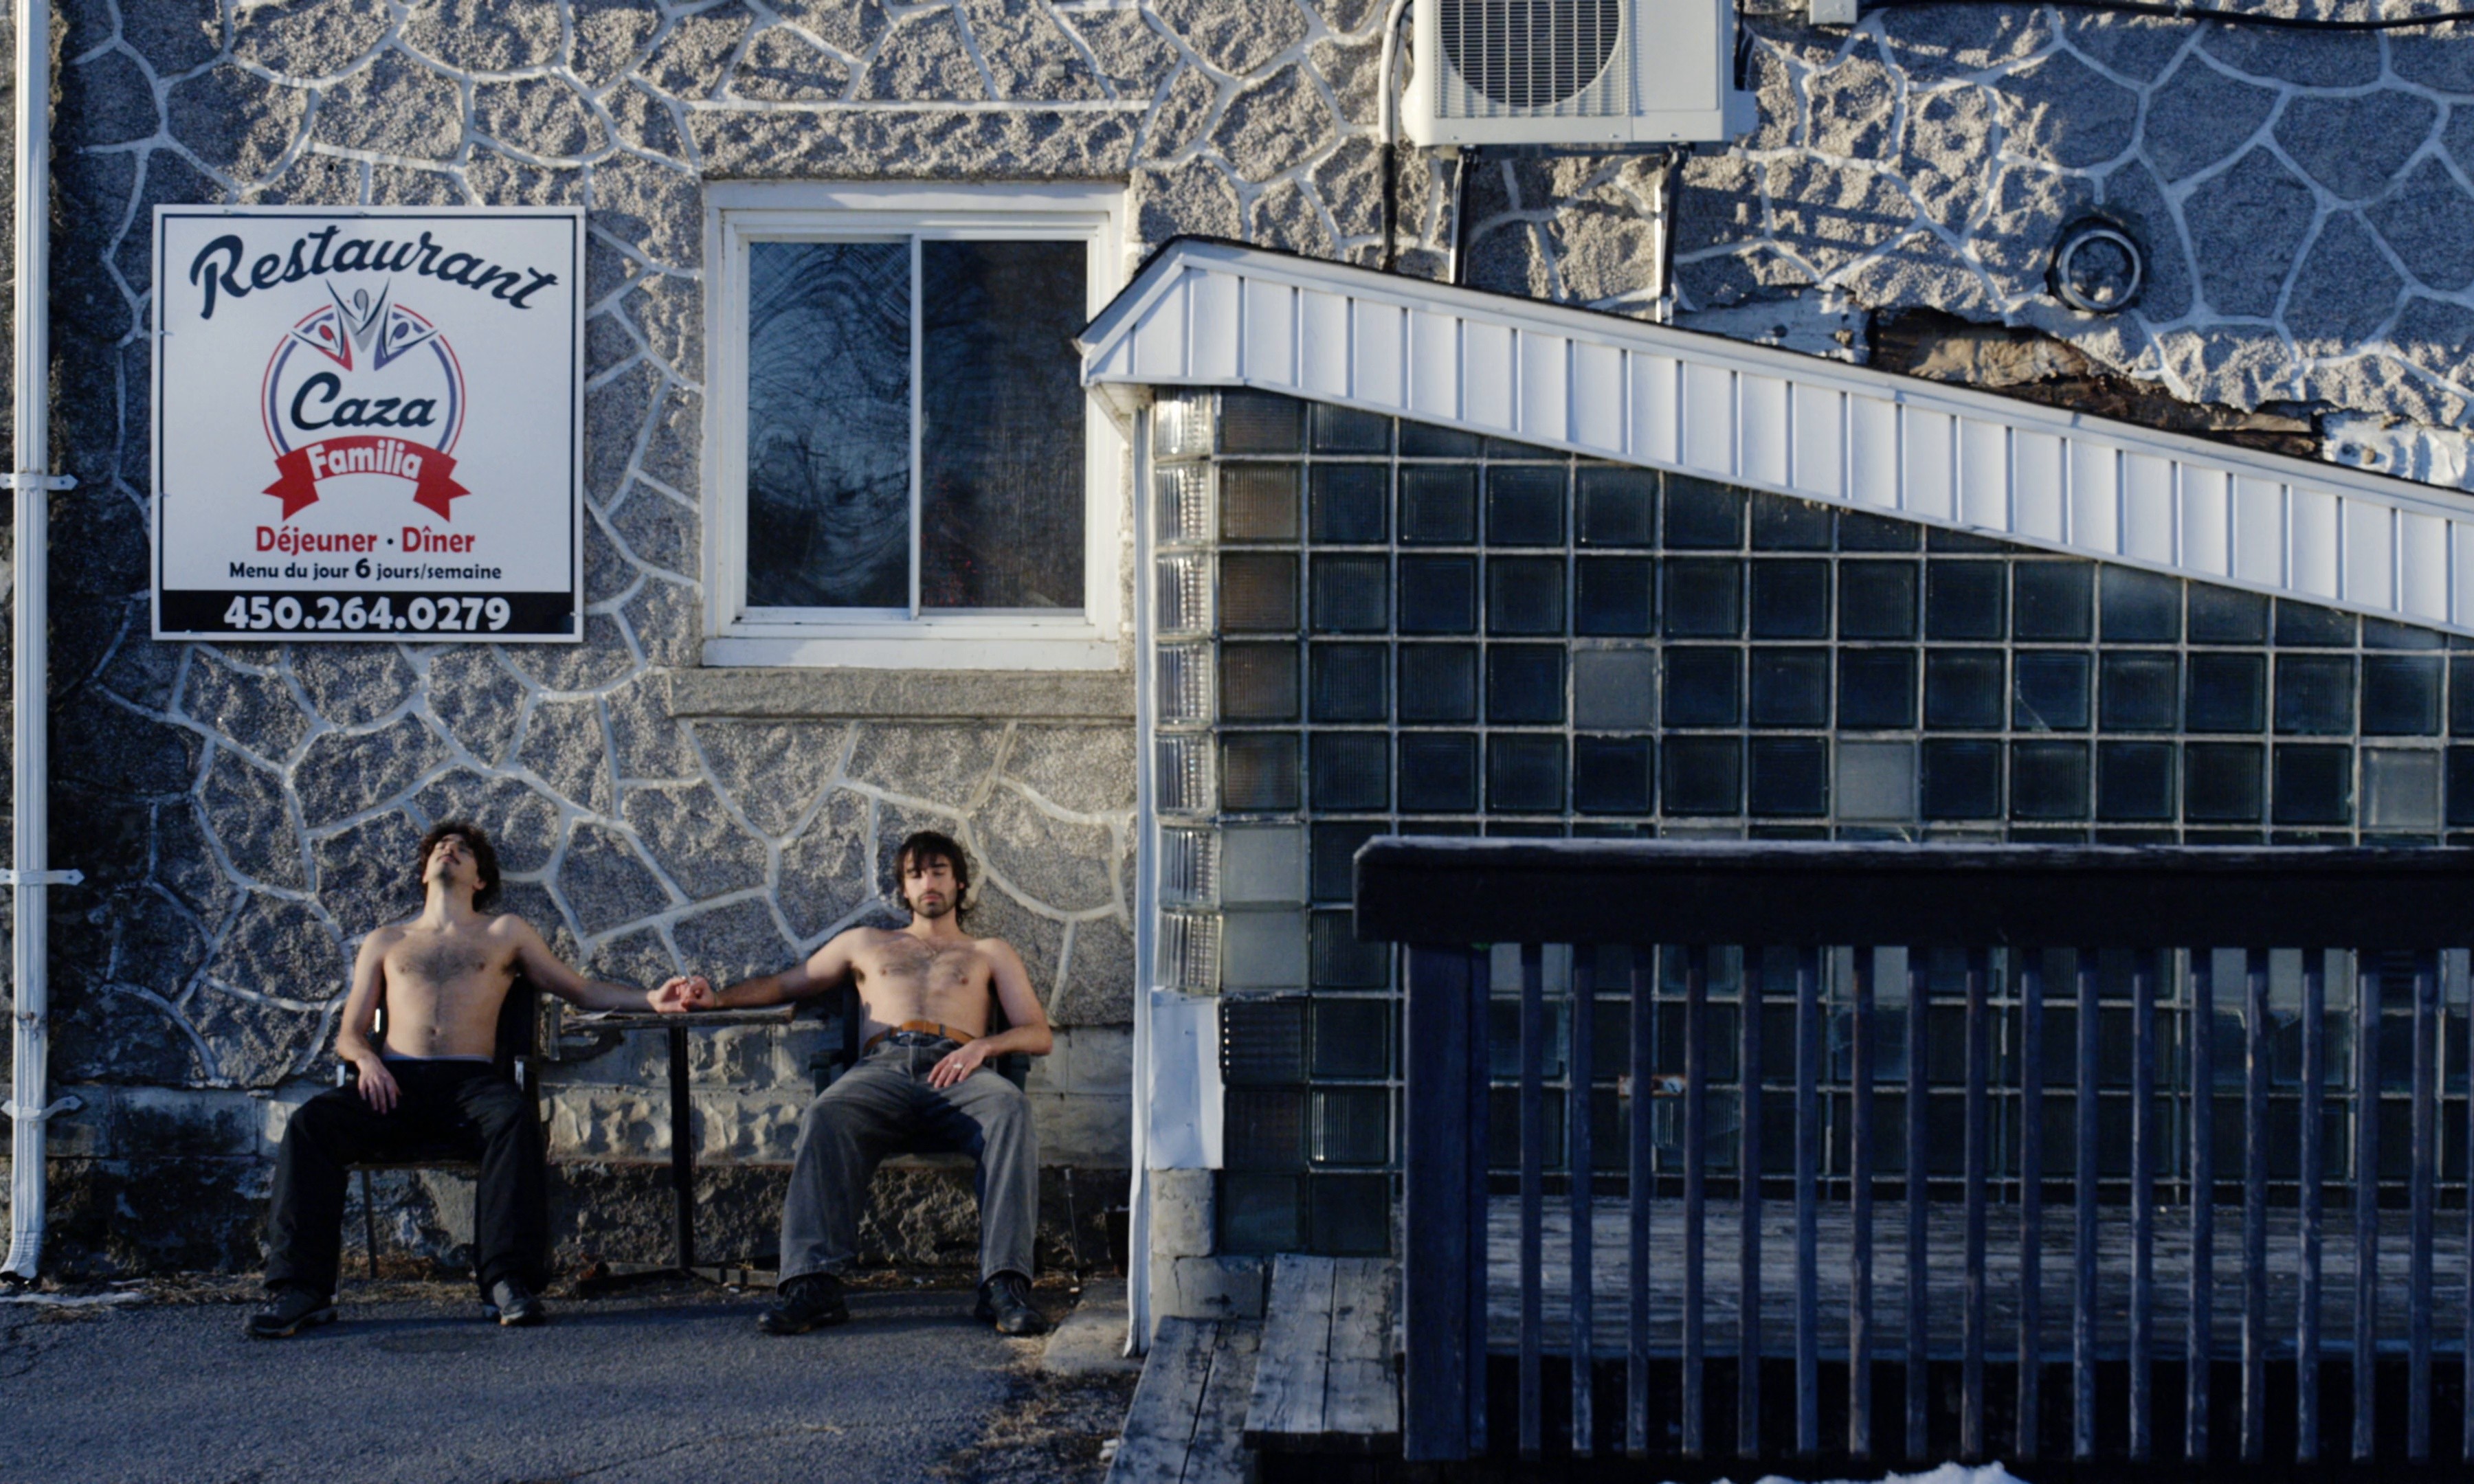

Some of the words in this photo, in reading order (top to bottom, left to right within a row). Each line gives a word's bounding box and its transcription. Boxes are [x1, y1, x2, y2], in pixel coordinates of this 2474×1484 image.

[189, 225, 559, 320] Restaurant
[290, 371, 437, 431] Caza
[305, 439, 423, 480] Familia
[255, 526, 378, 556] Déjeuner
[401, 526, 476, 552] Dîner
[229, 562, 279, 579] Menu
[284, 563, 309, 579] du
[312, 563, 350, 583] jour
[355, 558, 371, 579] 6
[376, 563, 502, 583] jours/semaine
[223, 596, 511, 631] 450.264.0279
